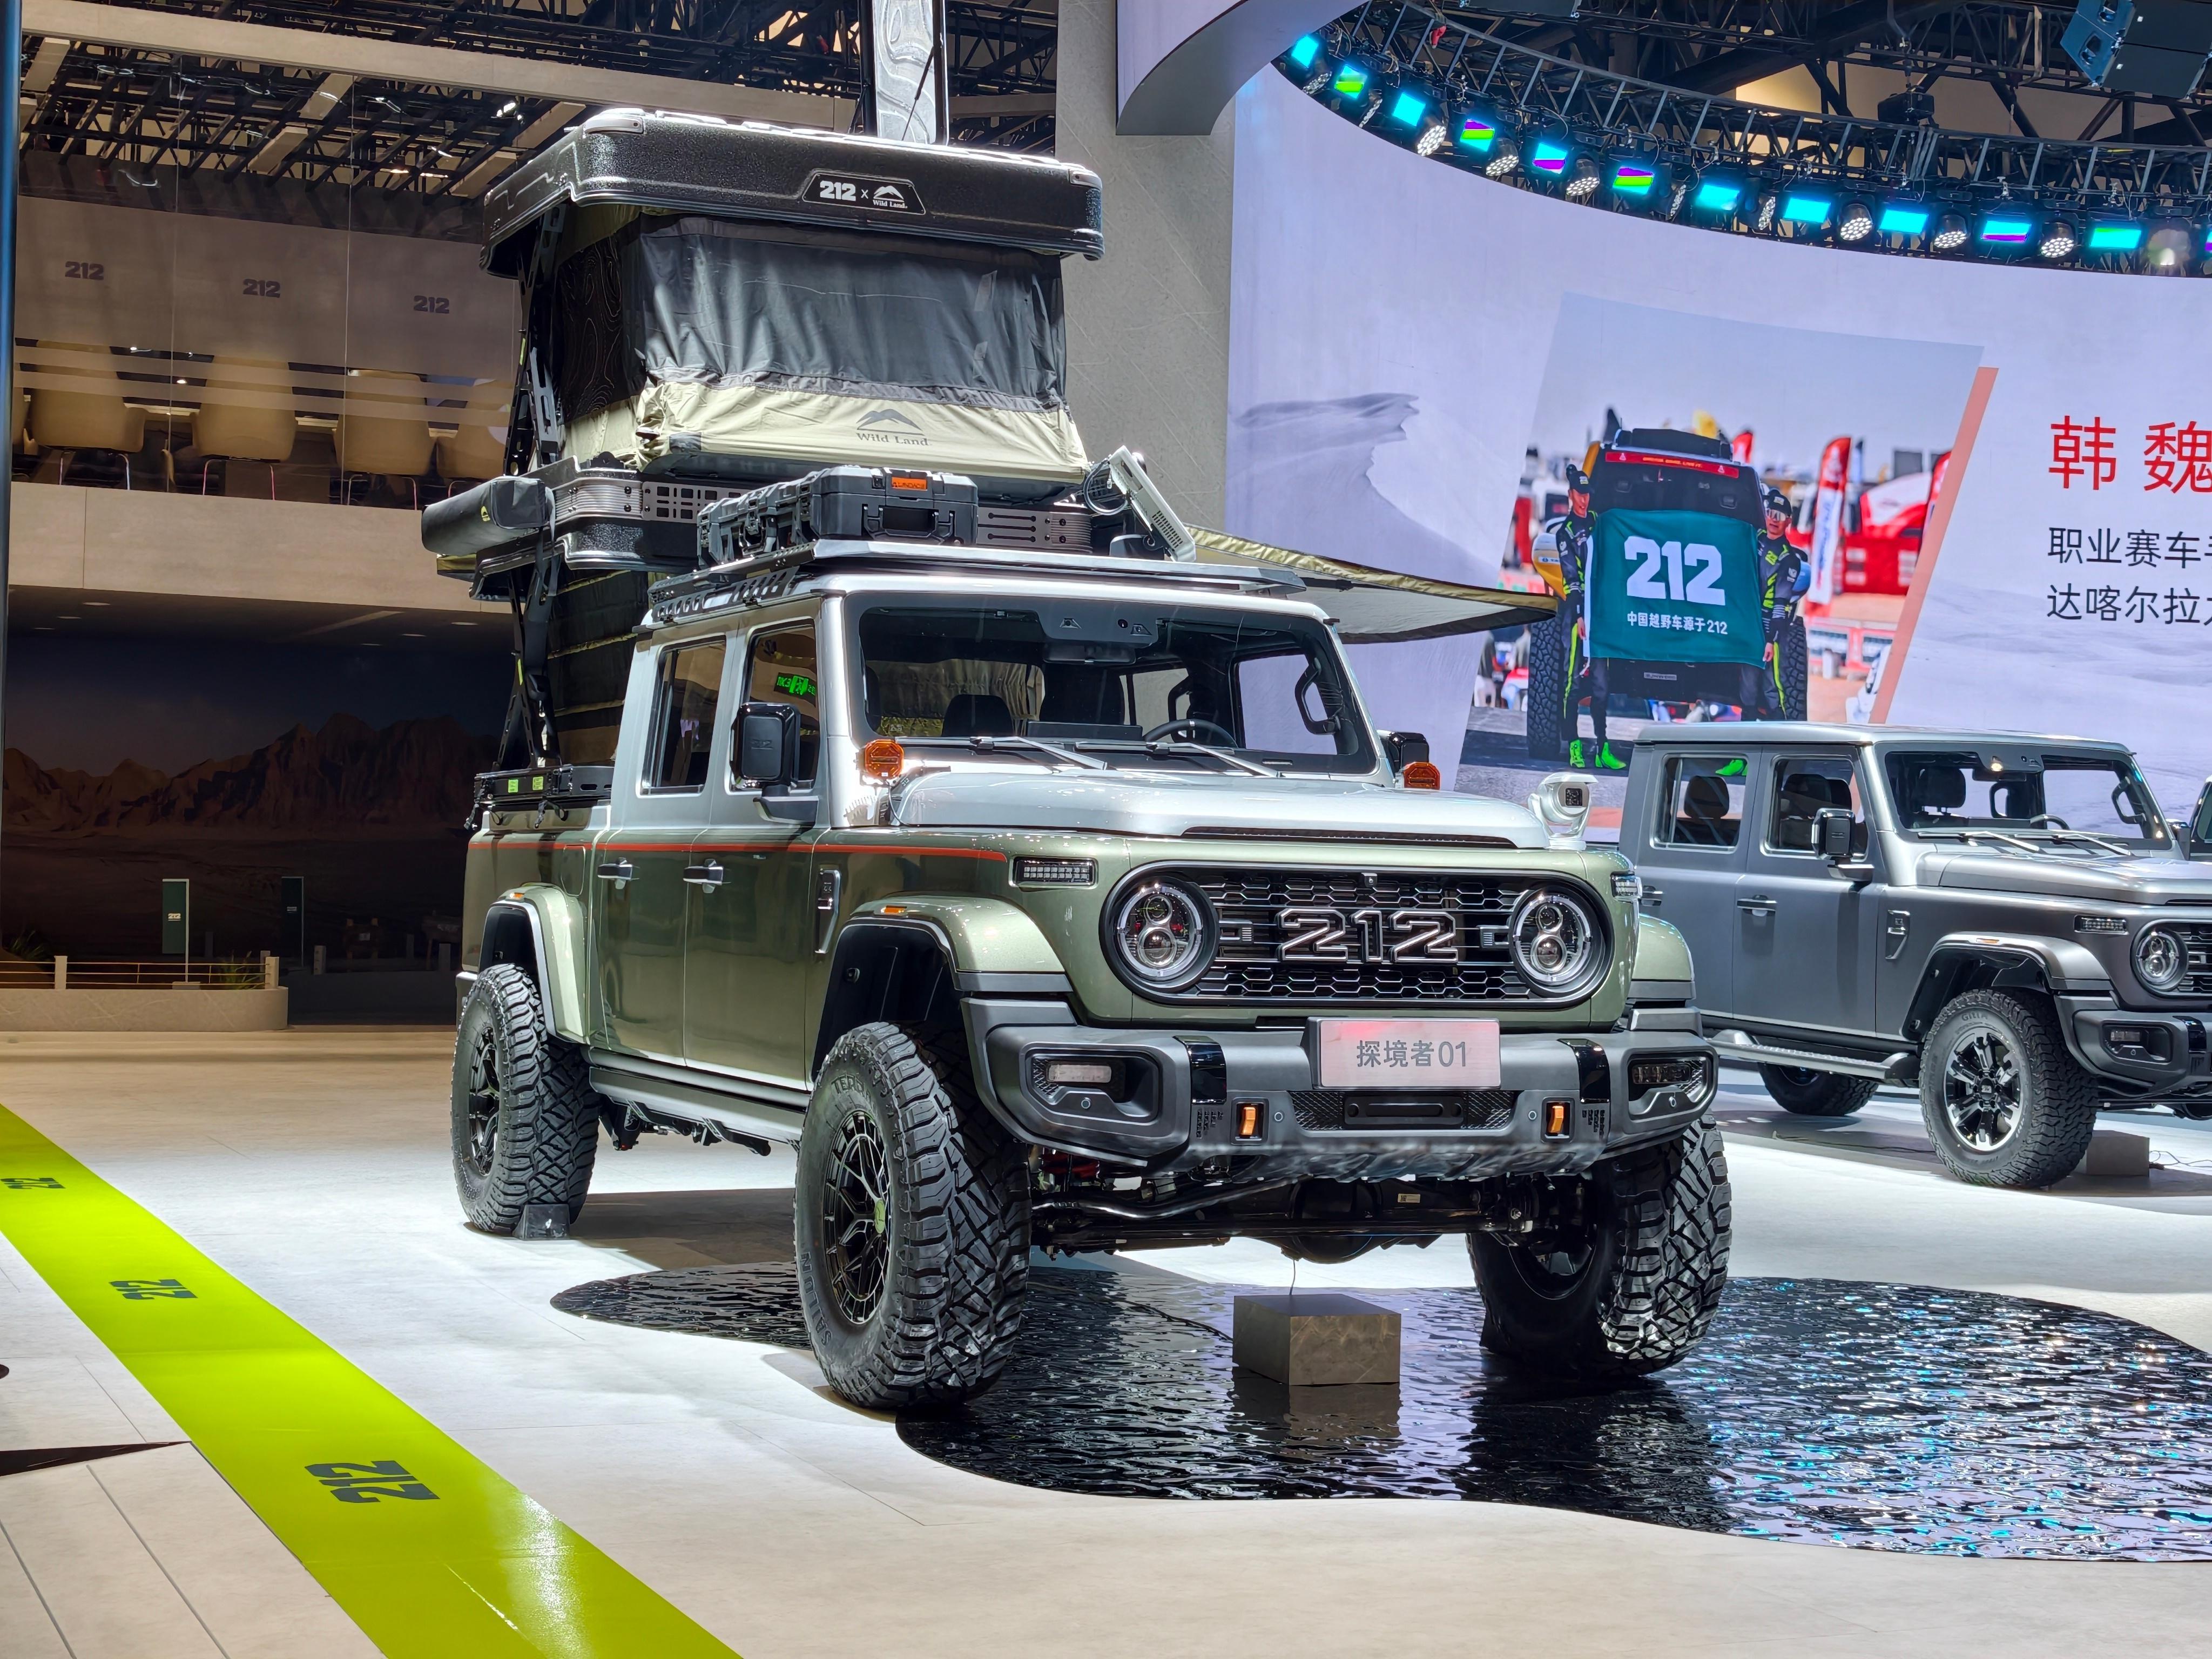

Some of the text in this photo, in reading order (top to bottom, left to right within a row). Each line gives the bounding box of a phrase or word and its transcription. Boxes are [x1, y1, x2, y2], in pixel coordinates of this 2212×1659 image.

[820, 180, 856, 201] 212
[65, 261, 104, 281] 212
[243, 279, 281, 298] 212
[413, 295, 450, 314] 212
[856, 433, 929, 446] Wild Land
[2048, 527, 2212, 569] 职业赛车
[1624, 536, 1725, 606] 212
[2047, 583, 2212, 626] 达喀尔拉
[1274, 907, 1459, 963] 212
[1356, 1040, 1466, 1067] 探境者01
[0, 1177, 66, 1189] 212
[109, 1279, 198, 1300] 212
[305, 1460, 441, 1503] 212
